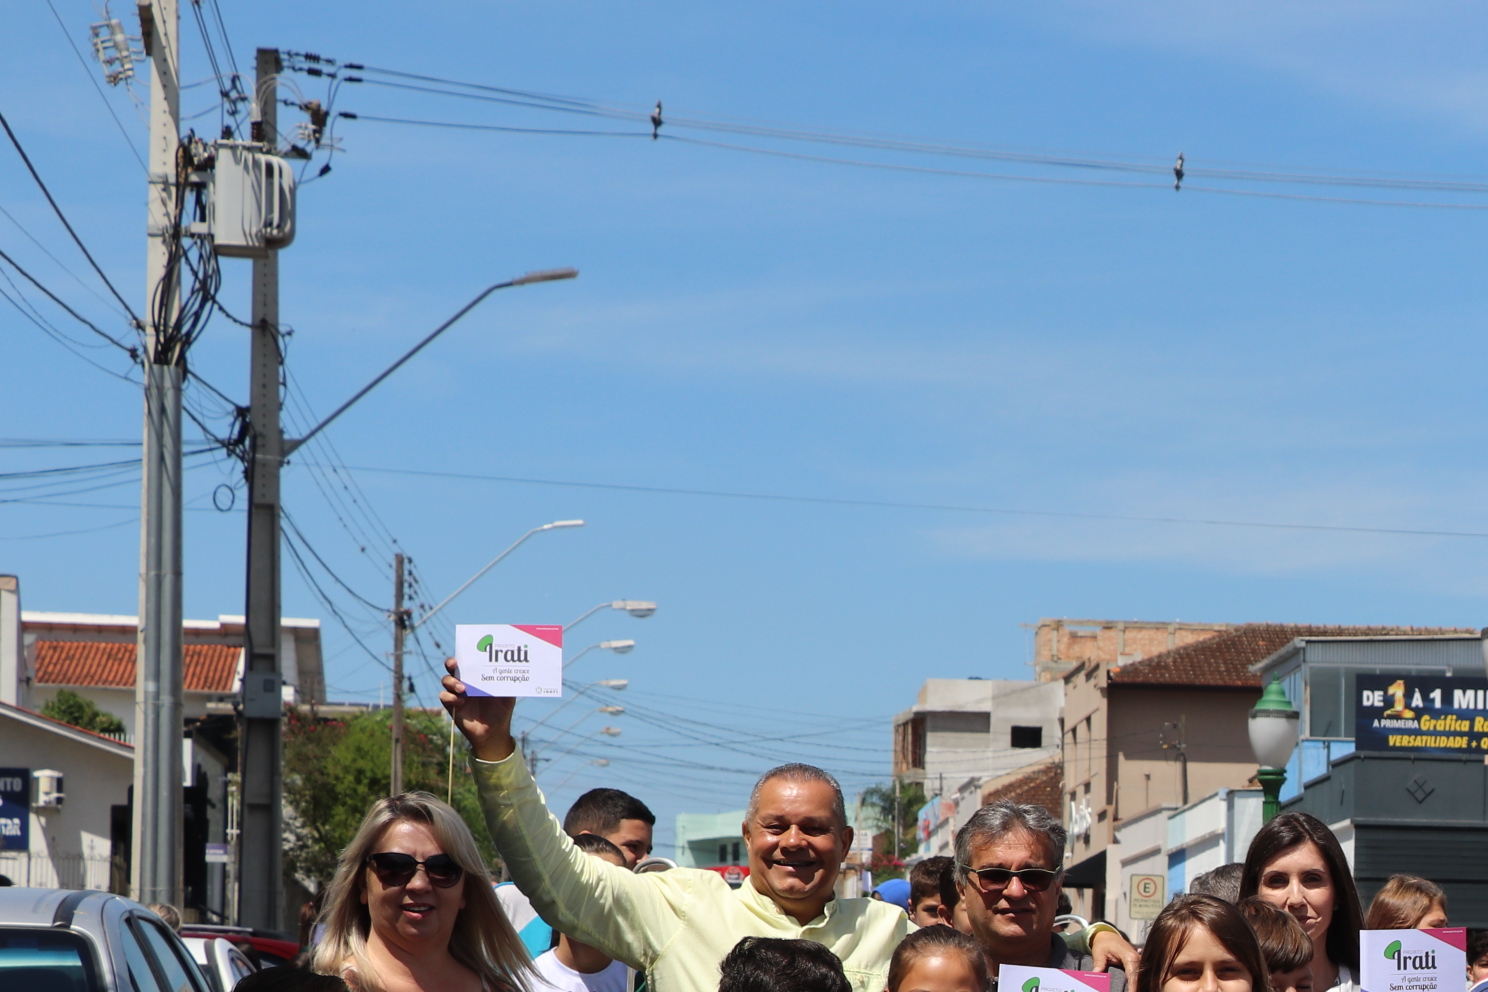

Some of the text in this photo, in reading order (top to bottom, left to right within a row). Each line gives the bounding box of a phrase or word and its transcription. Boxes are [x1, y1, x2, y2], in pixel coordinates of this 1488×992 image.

[484, 643, 530, 663] Irati
[1362, 690, 1384, 707] DE
[1385, 680, 1411, 717] 1
[1411, 688, 1423, 708] À
[1430, 688, 1442, 708] 1
[1372, 719, 1380, 728] A
[1380, 719, 1419, 729] PRIMEIRA
[1420, 715, 1470, 732] Gráfica
[1388, 735, 1468, 748] VERSATILIDADE
[1144, 882, 1151, 893] E
[1392, 949, 1437, 971] Irati
[1390, 983, 1437, 992] Sem corrupção
